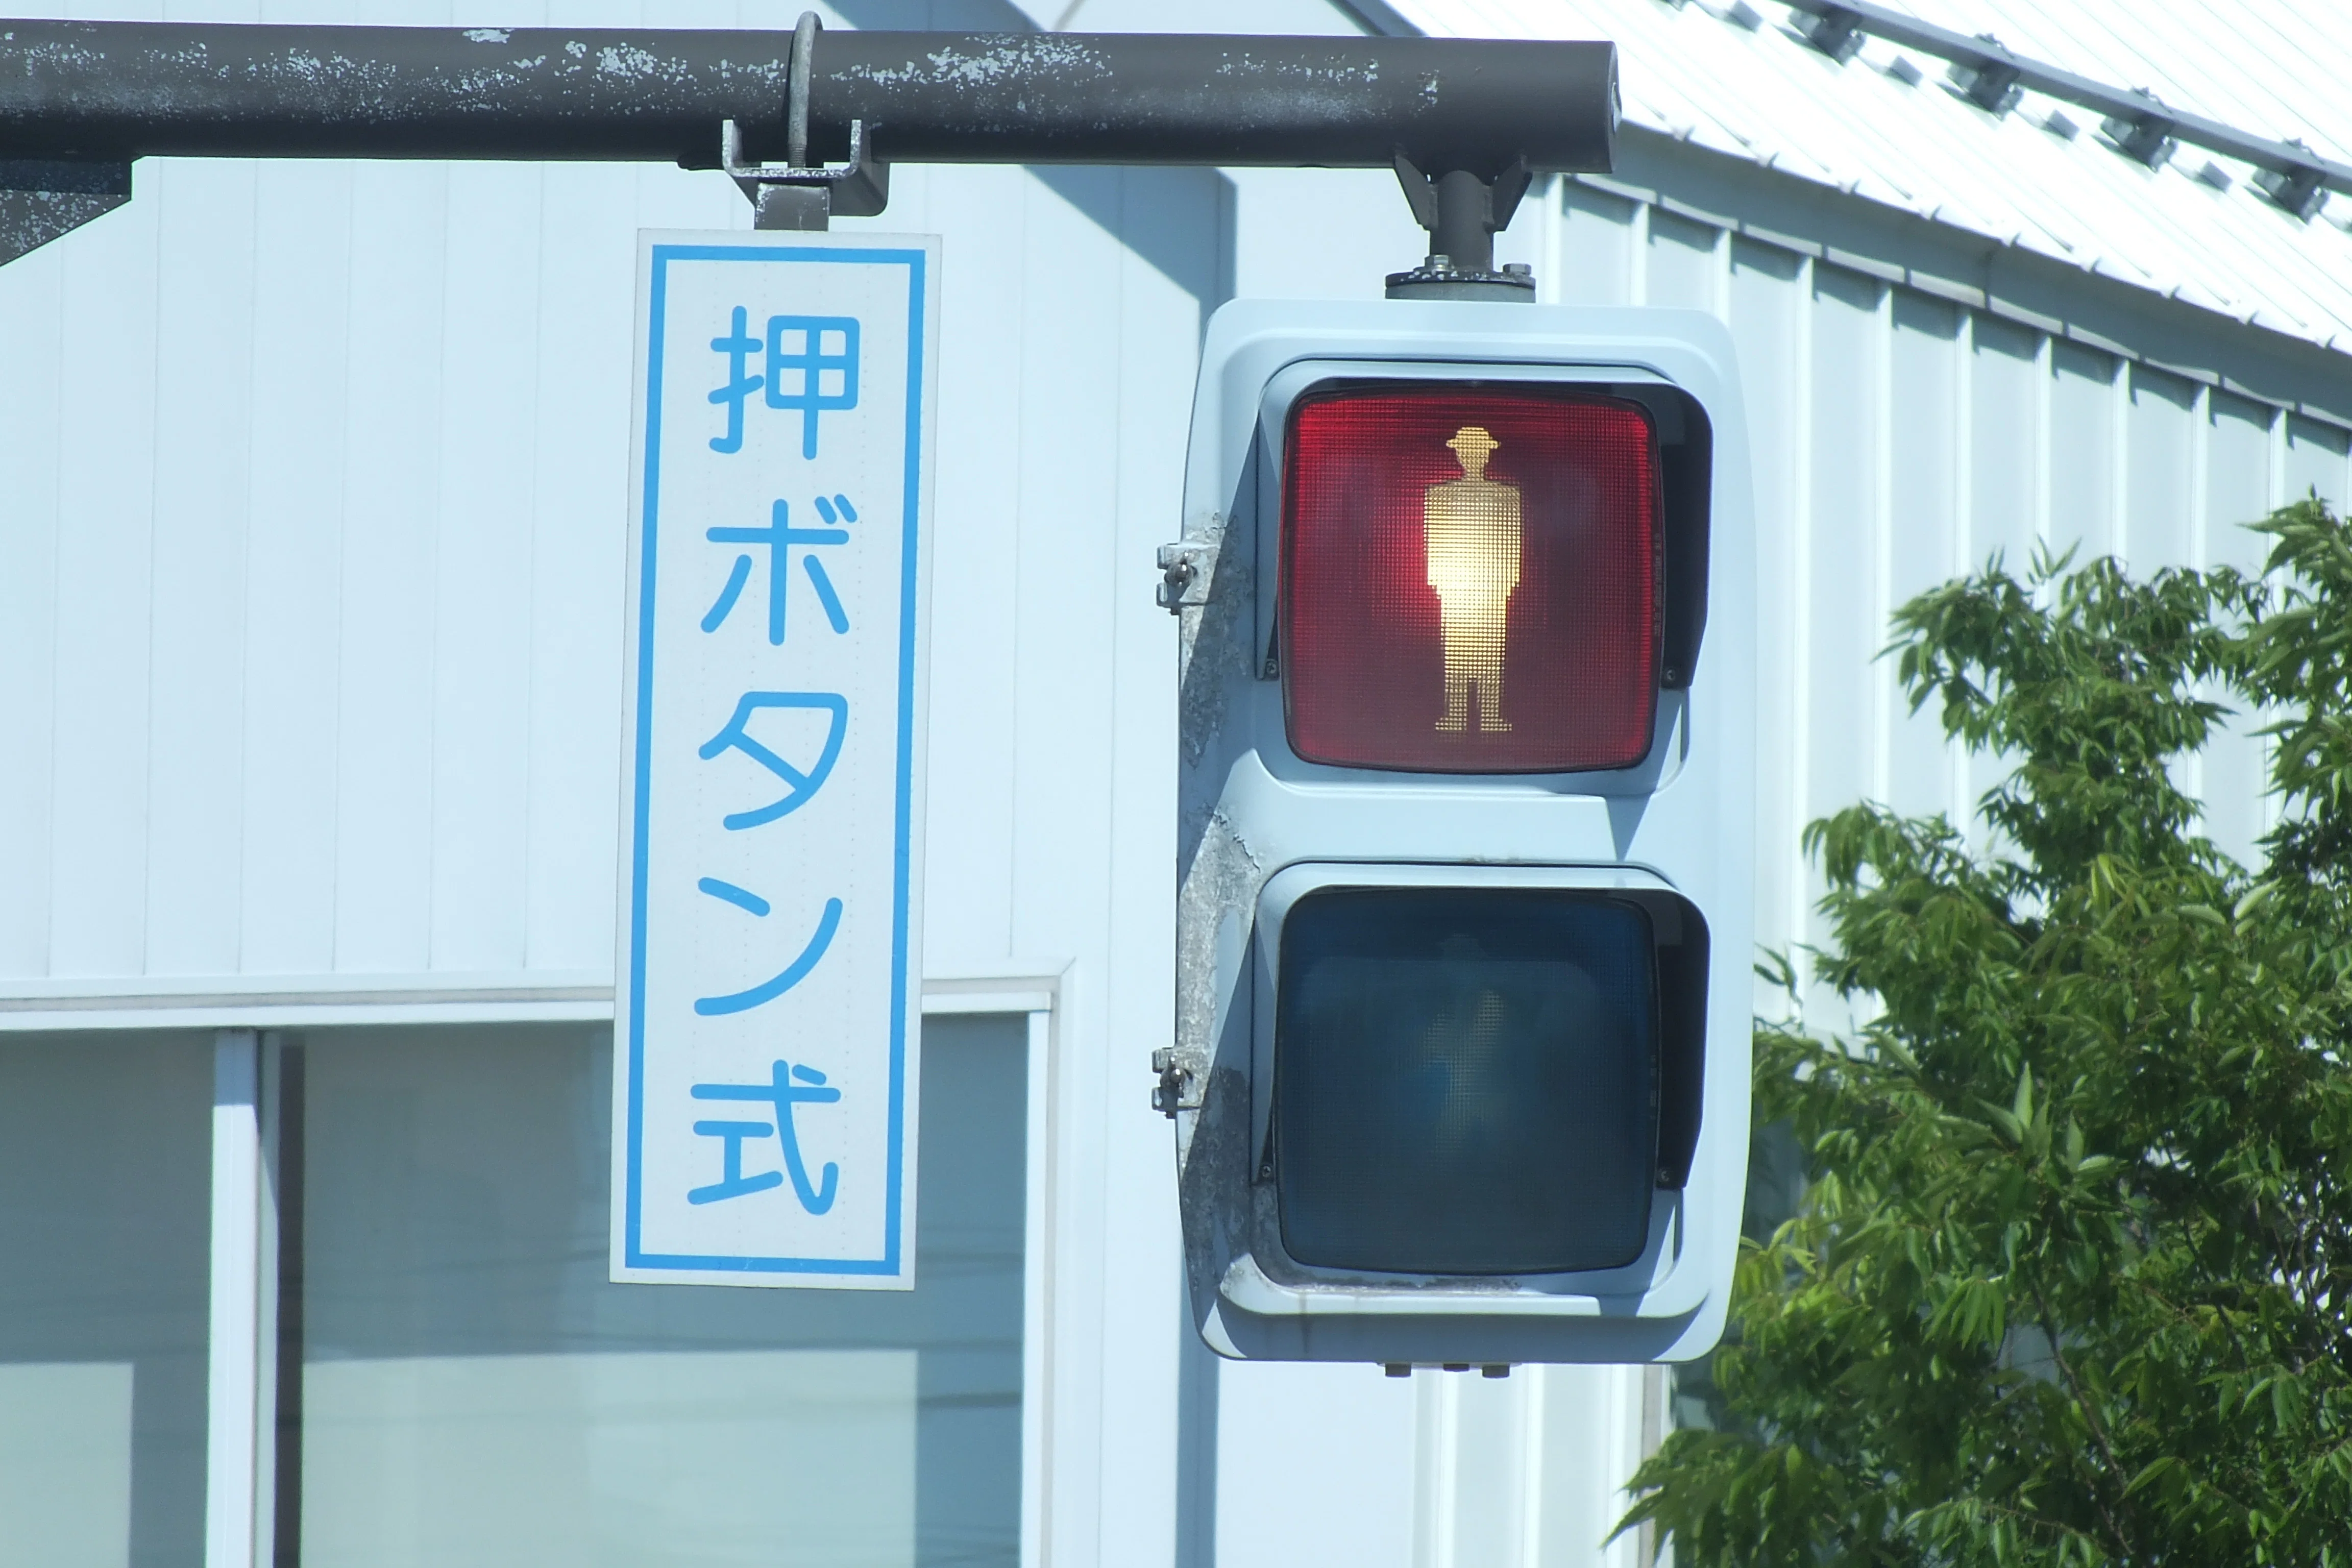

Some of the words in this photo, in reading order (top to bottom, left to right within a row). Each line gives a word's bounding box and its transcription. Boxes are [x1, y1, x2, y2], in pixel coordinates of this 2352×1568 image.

[688, 306, 861, 1215] 押ボタン式
